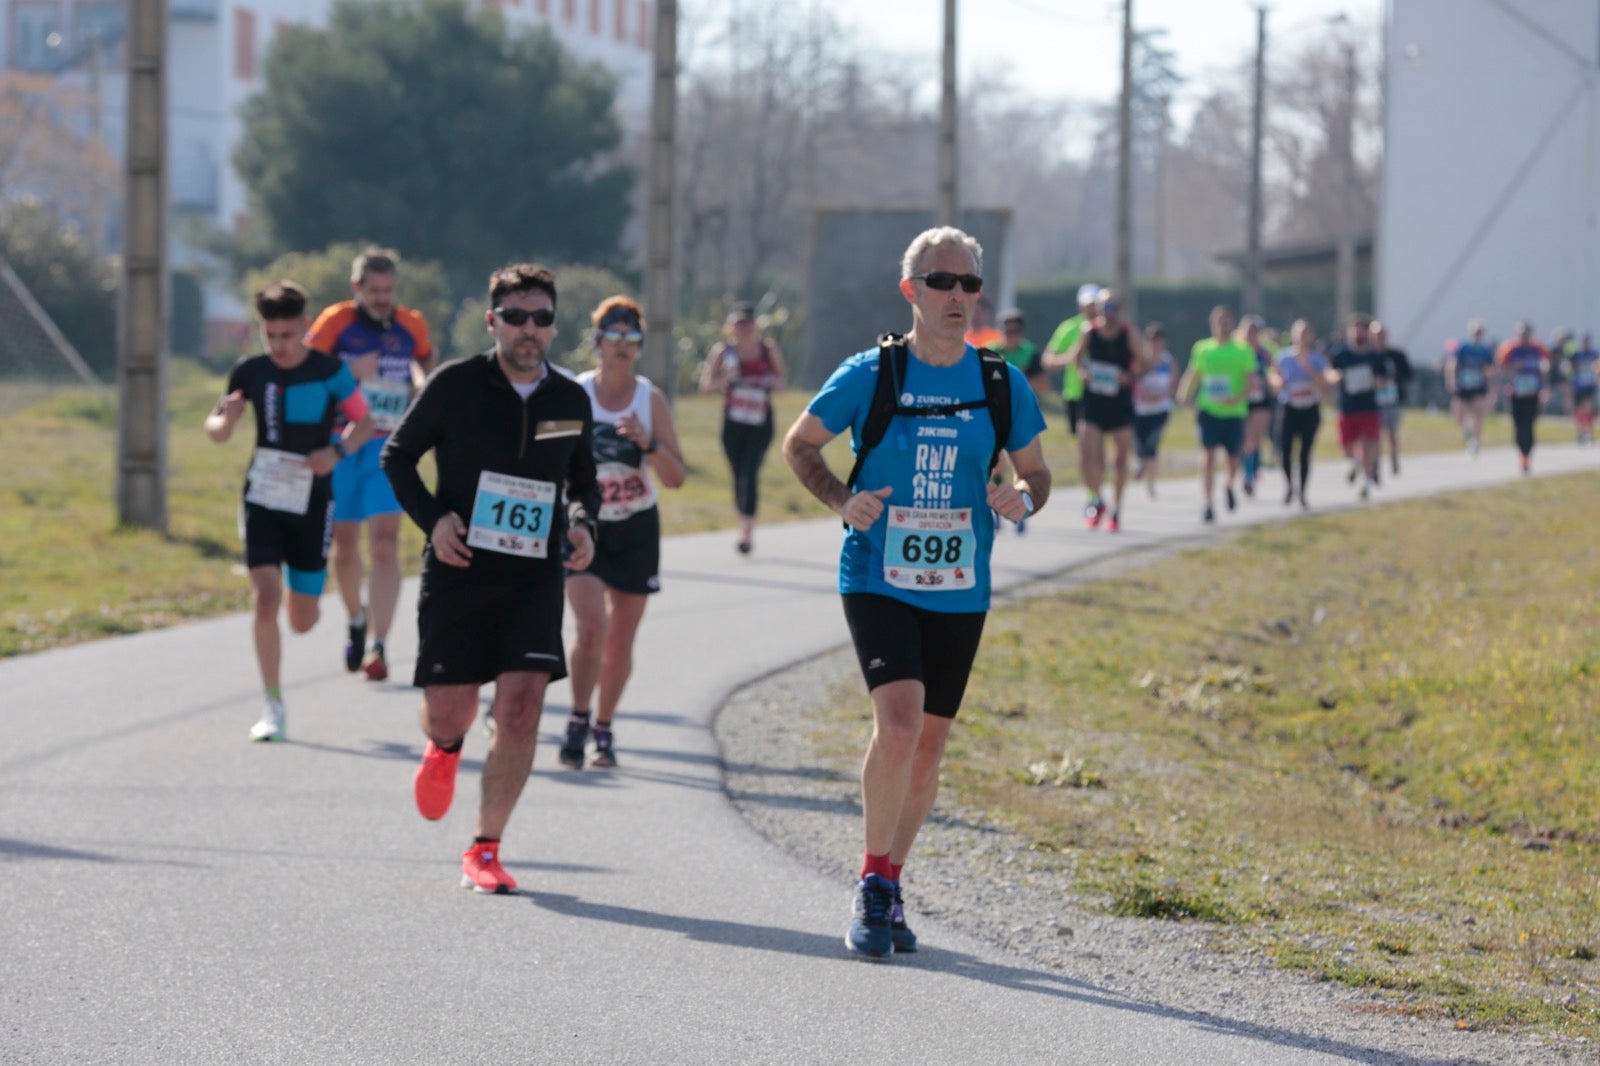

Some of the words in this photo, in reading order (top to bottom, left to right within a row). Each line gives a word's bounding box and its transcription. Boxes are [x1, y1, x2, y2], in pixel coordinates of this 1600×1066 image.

[916, 395, 952, 405] ZURICH
[915, 444, 958, 471] RUN
[491, 500, 543, 533] 163
[902, 534, 962, 564] 698
